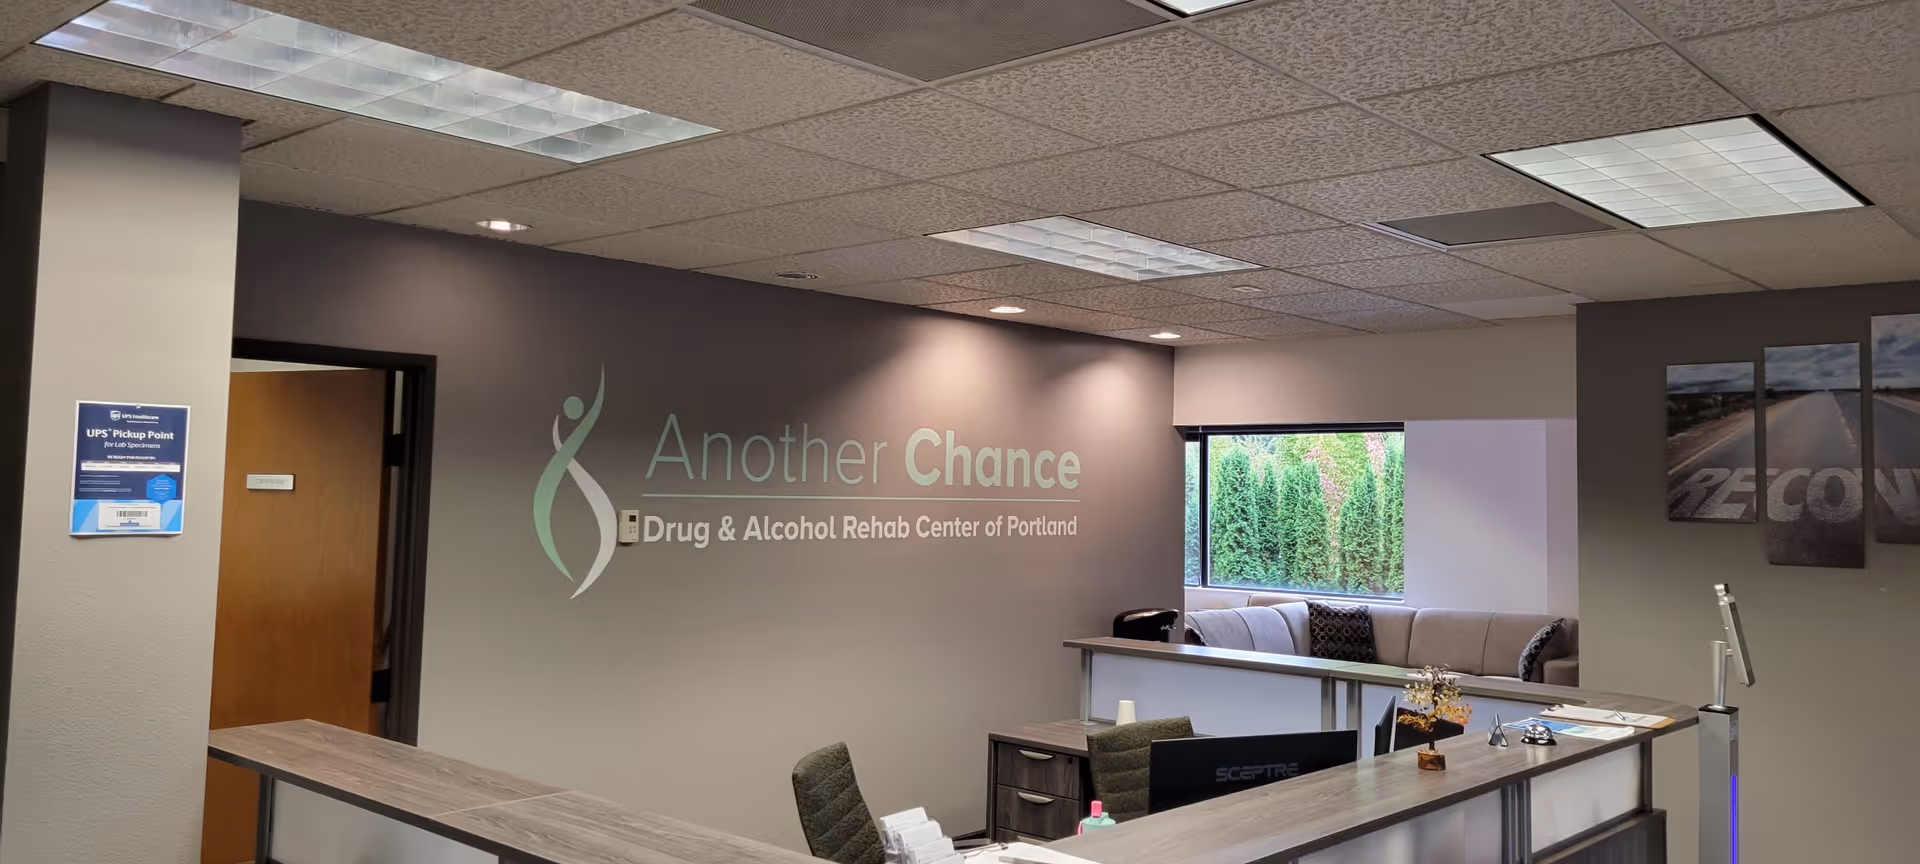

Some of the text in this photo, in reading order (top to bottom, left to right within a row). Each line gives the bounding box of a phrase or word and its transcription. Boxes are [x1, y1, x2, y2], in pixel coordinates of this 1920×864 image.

[104, 441, 114, 449] for
[113, 429, 146, 440] Pickup
[148, 431, 174, 440] Point
[645, 413, 1081, 489] Another Chance
[1669, 467, 1920, 523] RECOV
[643, 515, 1078, 549] Drug & Alcohol Rehab Center of Portland
[1215, 762, 1299, 782] SCEPTRE
